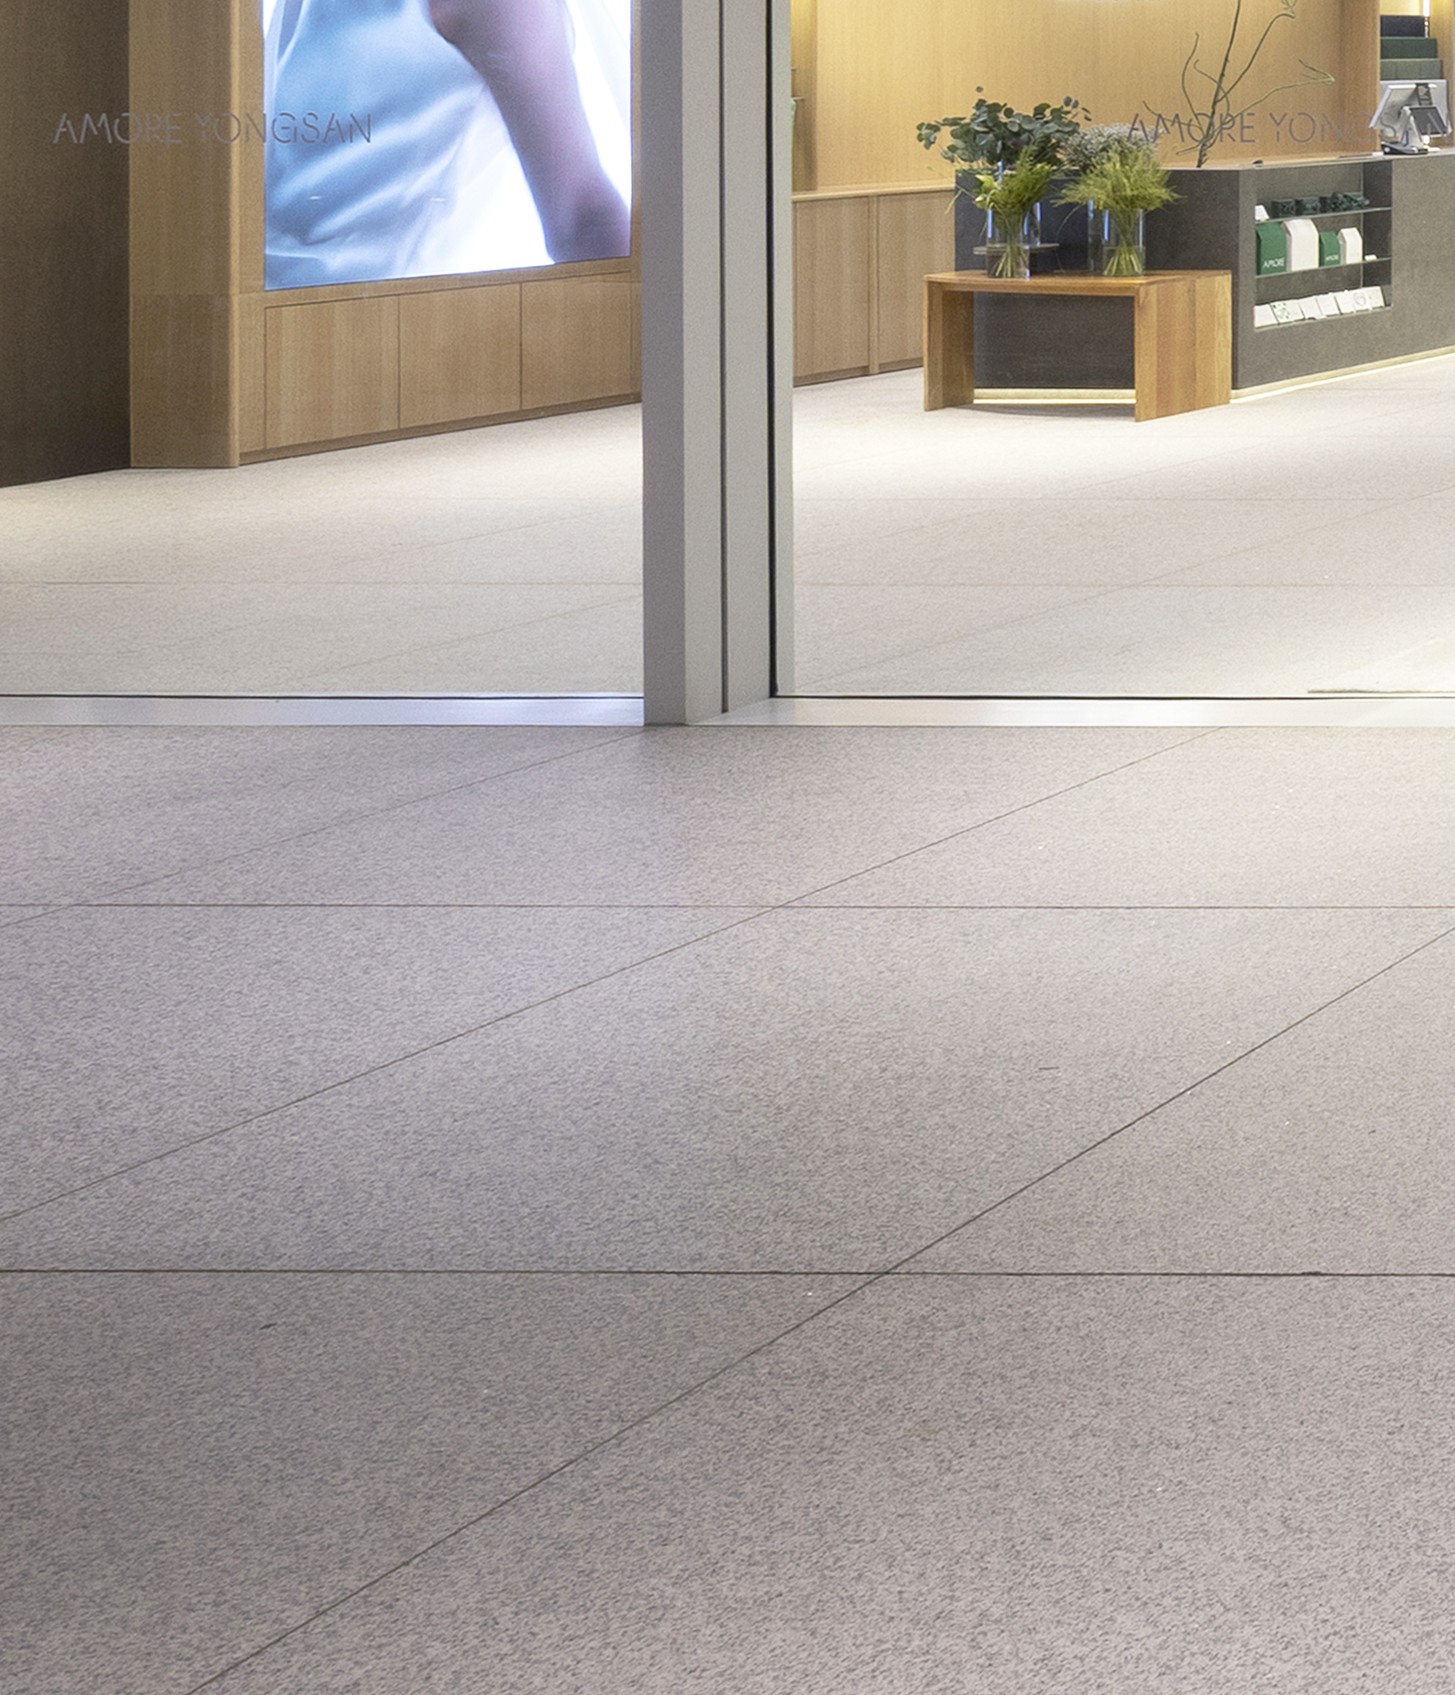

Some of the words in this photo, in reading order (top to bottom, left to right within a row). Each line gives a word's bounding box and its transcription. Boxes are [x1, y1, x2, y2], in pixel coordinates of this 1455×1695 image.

[53, 112, 184, 144] AMORE
[196, 112, 373, 144] YONGSAN
[1126, 112, 1256, 144] AMORE
